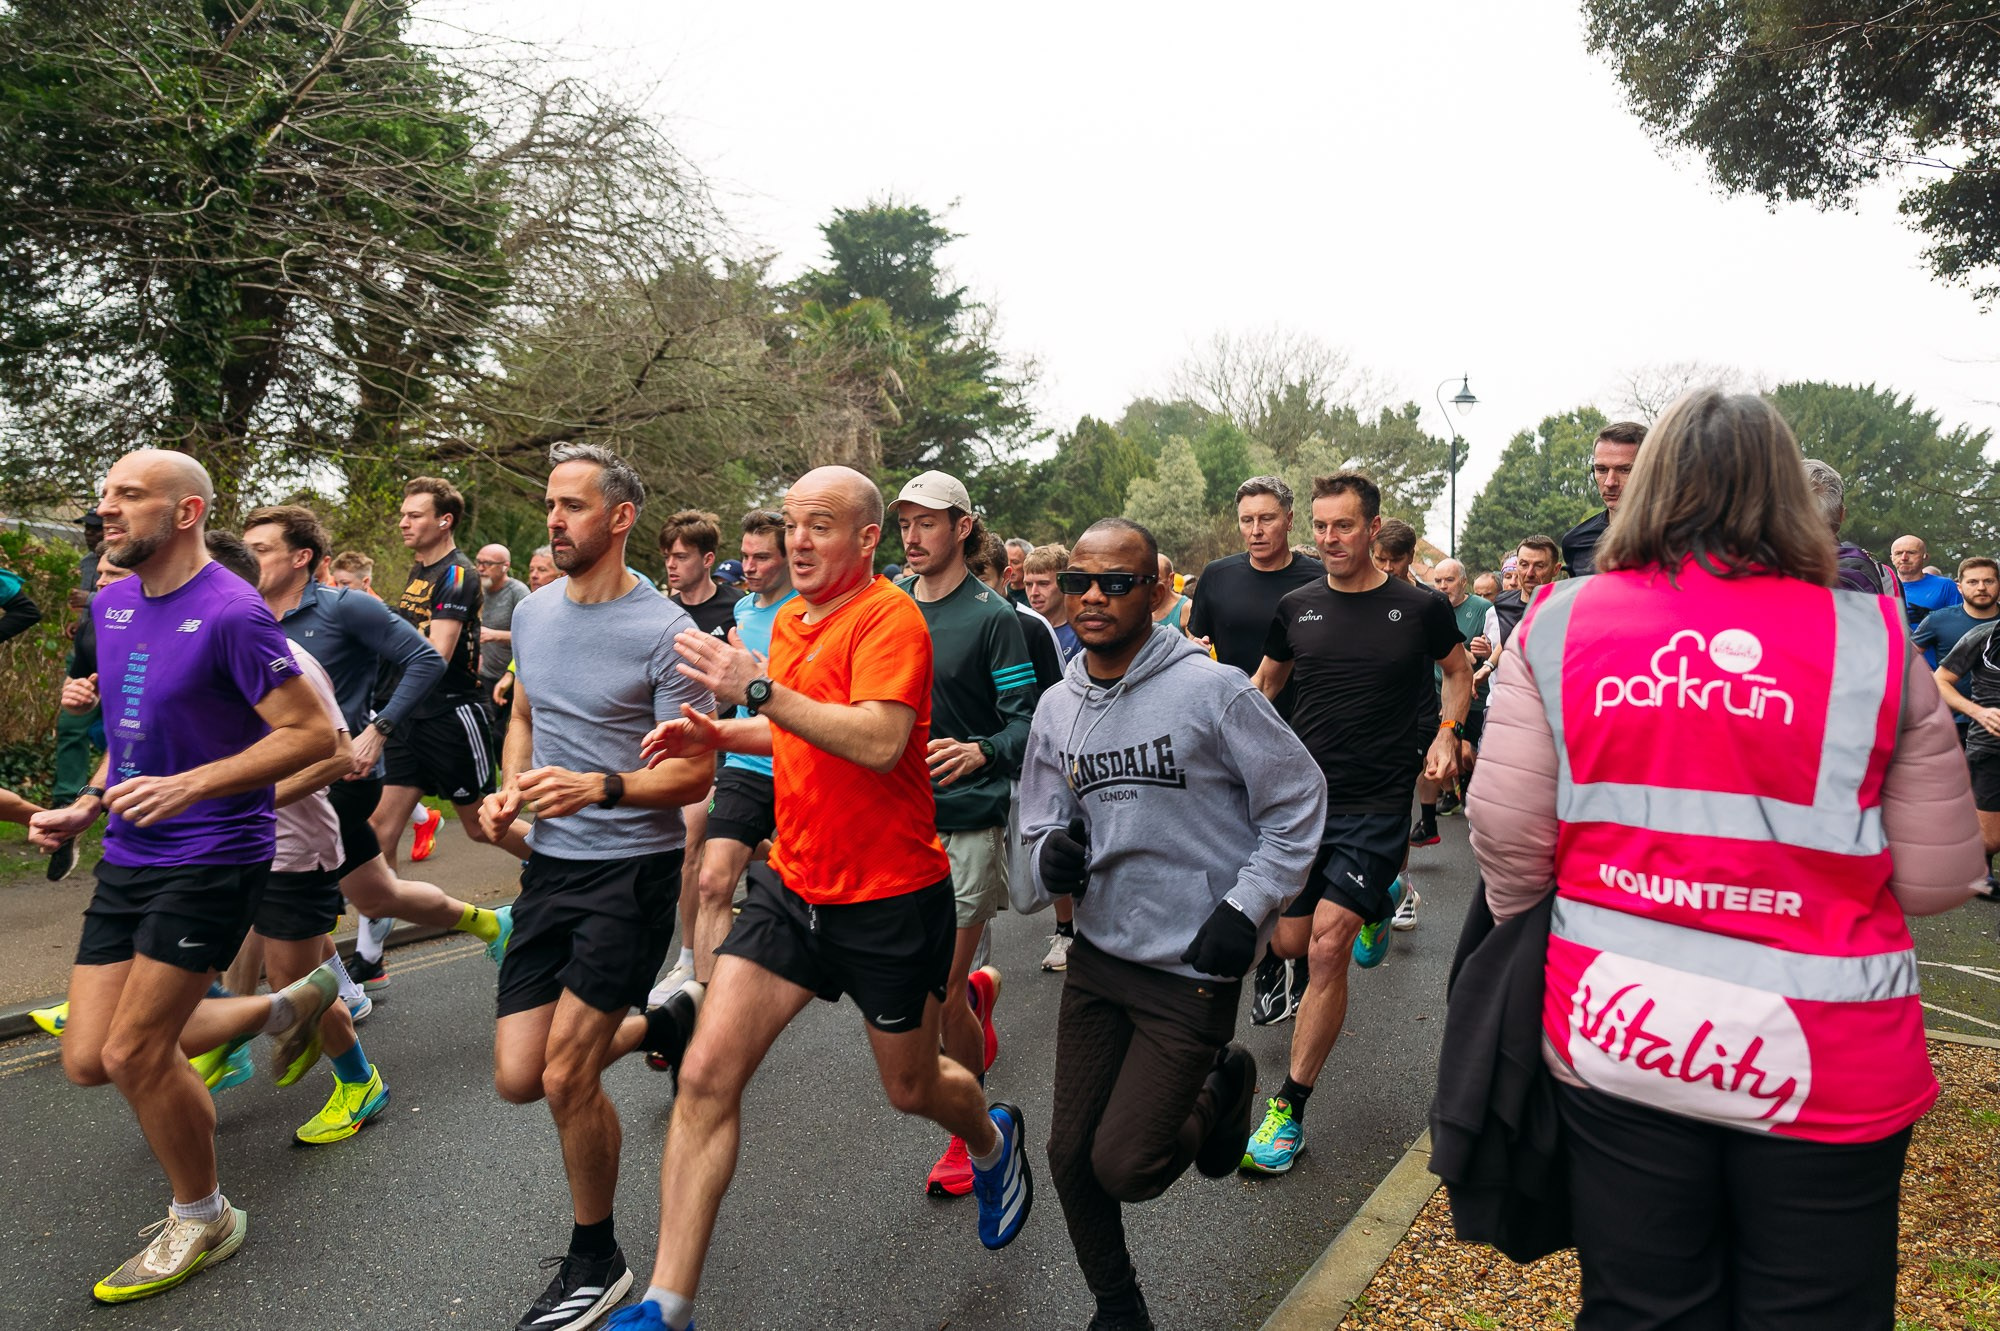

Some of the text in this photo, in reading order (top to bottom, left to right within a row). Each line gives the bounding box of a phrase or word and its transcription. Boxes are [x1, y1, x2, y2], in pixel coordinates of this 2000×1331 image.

[1594, 630, 1795, 726] parkrun
[1599, 863, 1804, 918] VOLUNTEER
[1578, 983, 1797, 1121] Vitality
